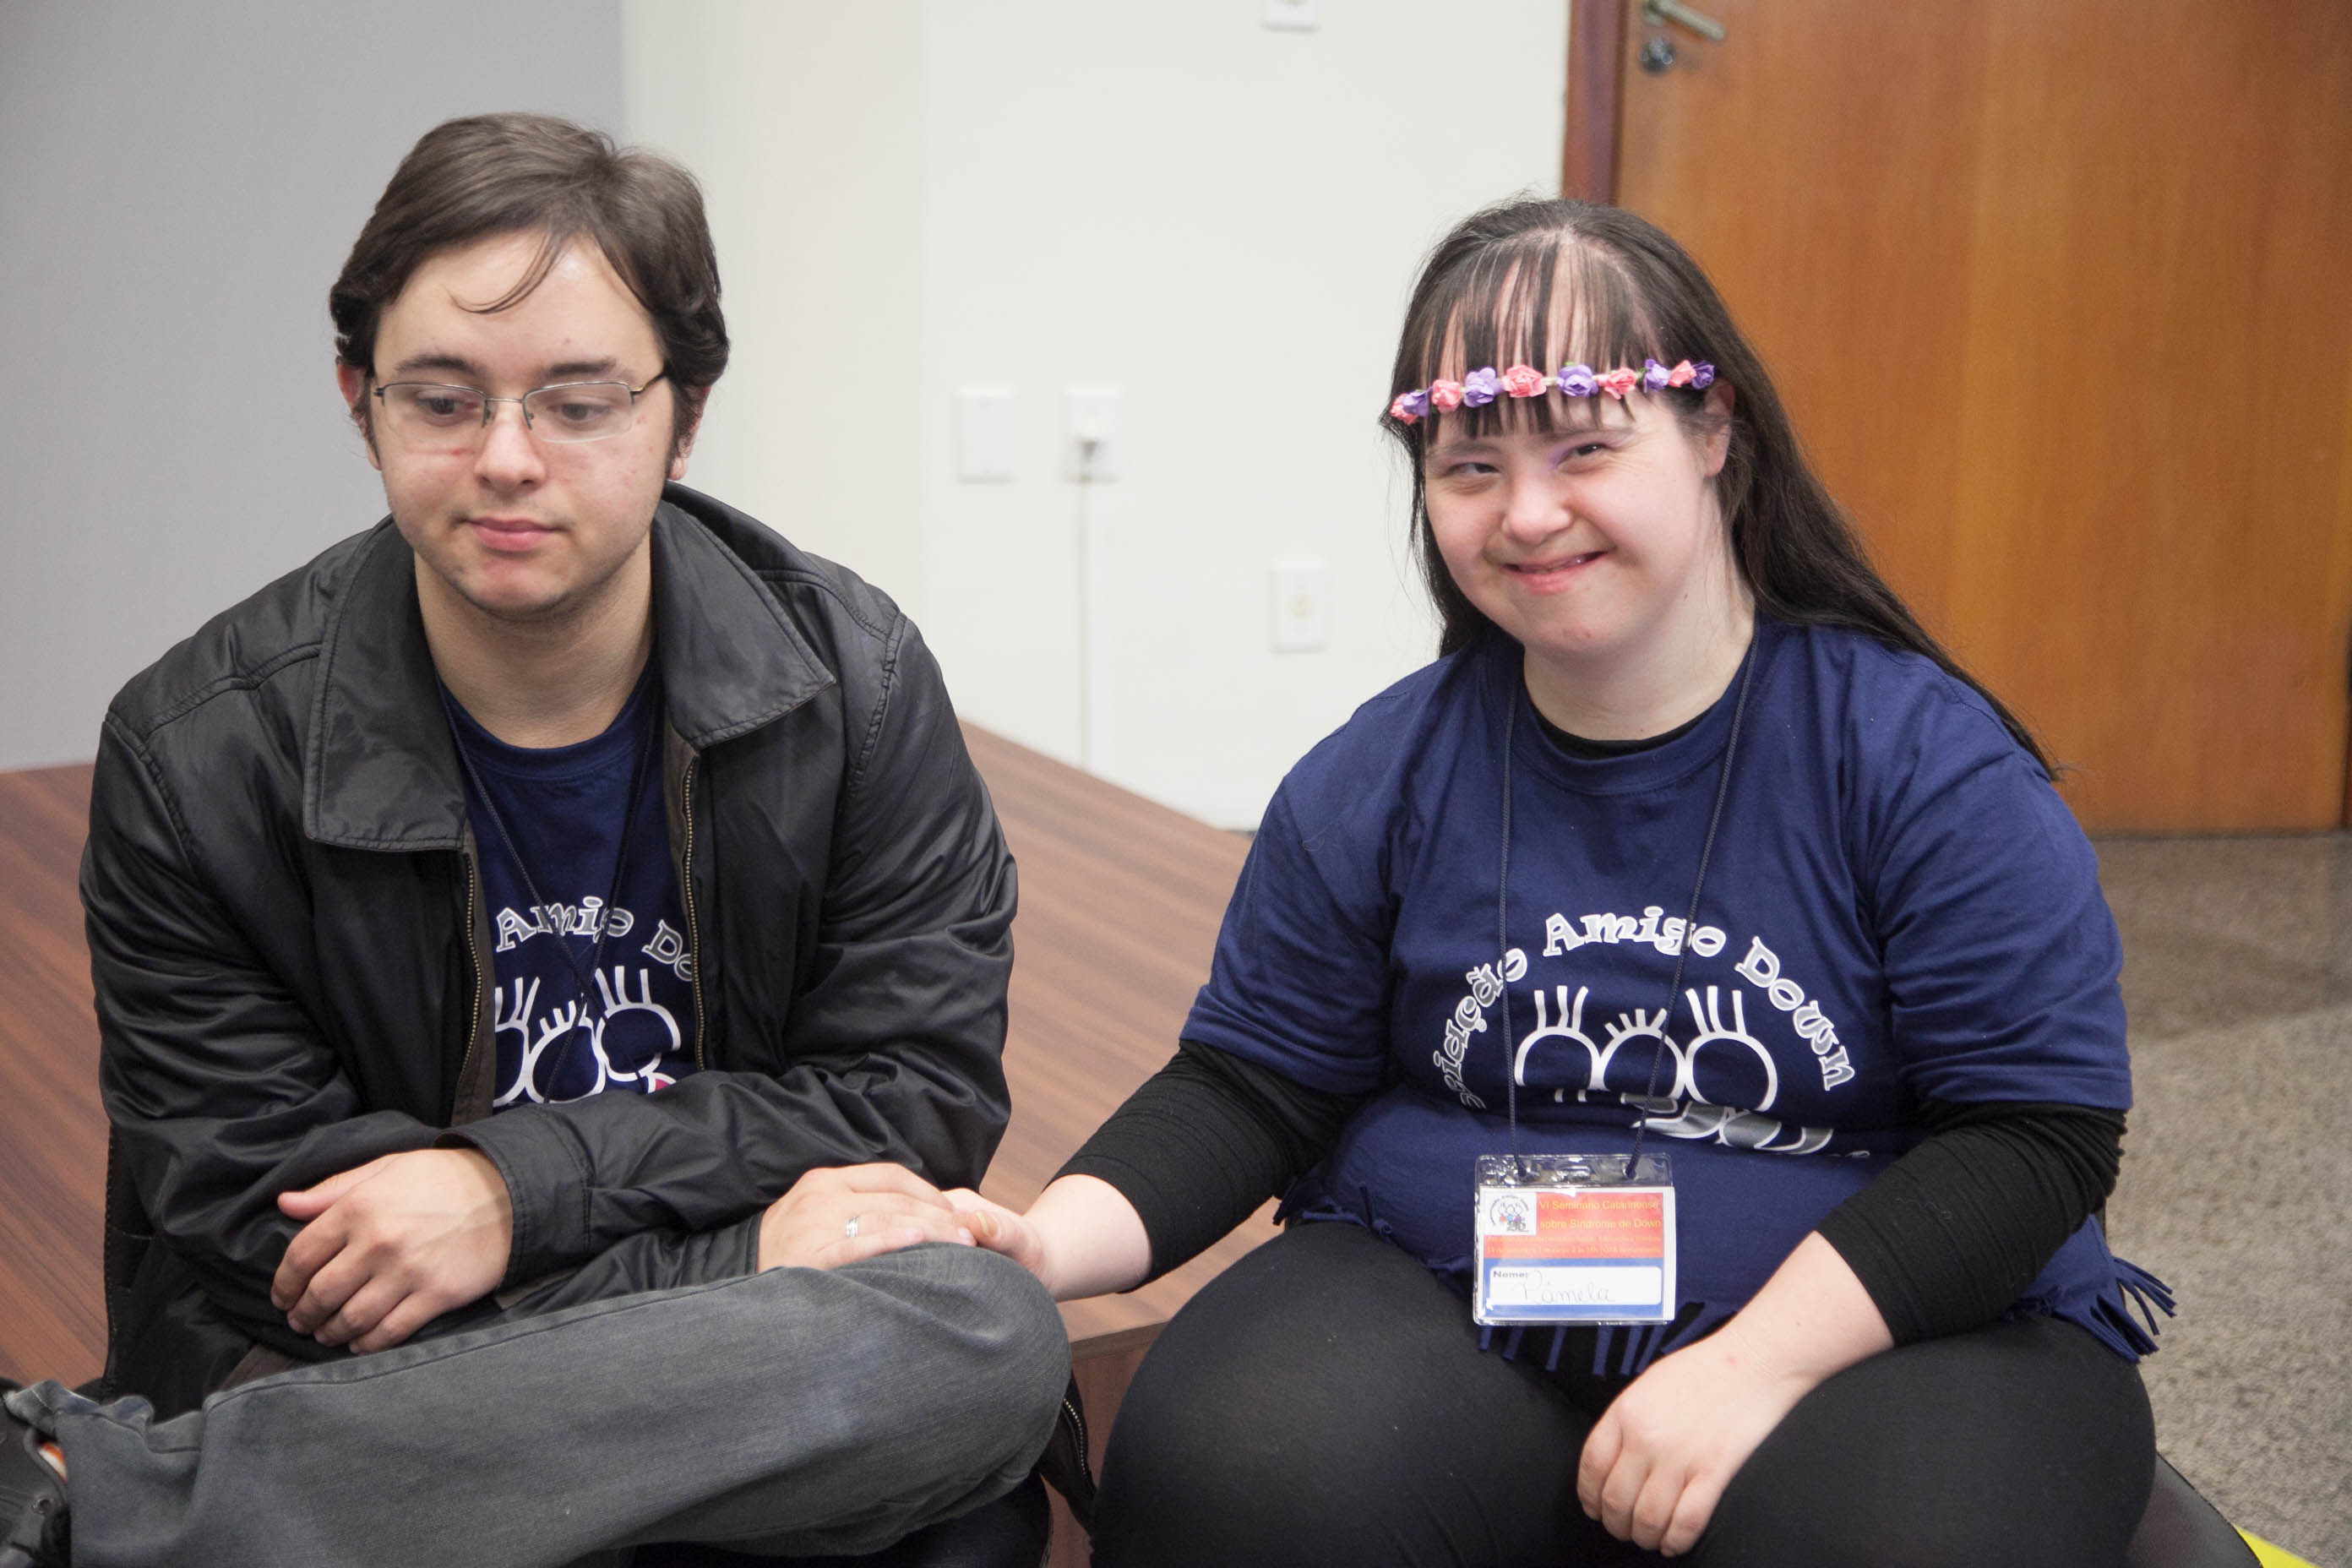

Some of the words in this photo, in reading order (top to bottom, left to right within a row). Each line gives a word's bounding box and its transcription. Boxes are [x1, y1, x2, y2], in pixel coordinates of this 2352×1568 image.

[641, 919, 693, 982] Do
[1543, 906, 1727, 957] Amigo
[1734, 936, 1855, 1091] Down
[1540, 1219, 1566, 1229] sobre
[1619, 1219, 1631, 1228] de
[1634, 1218, 1662, 1229] Down
[1492, 1270, 1528, 1279] Nome:
